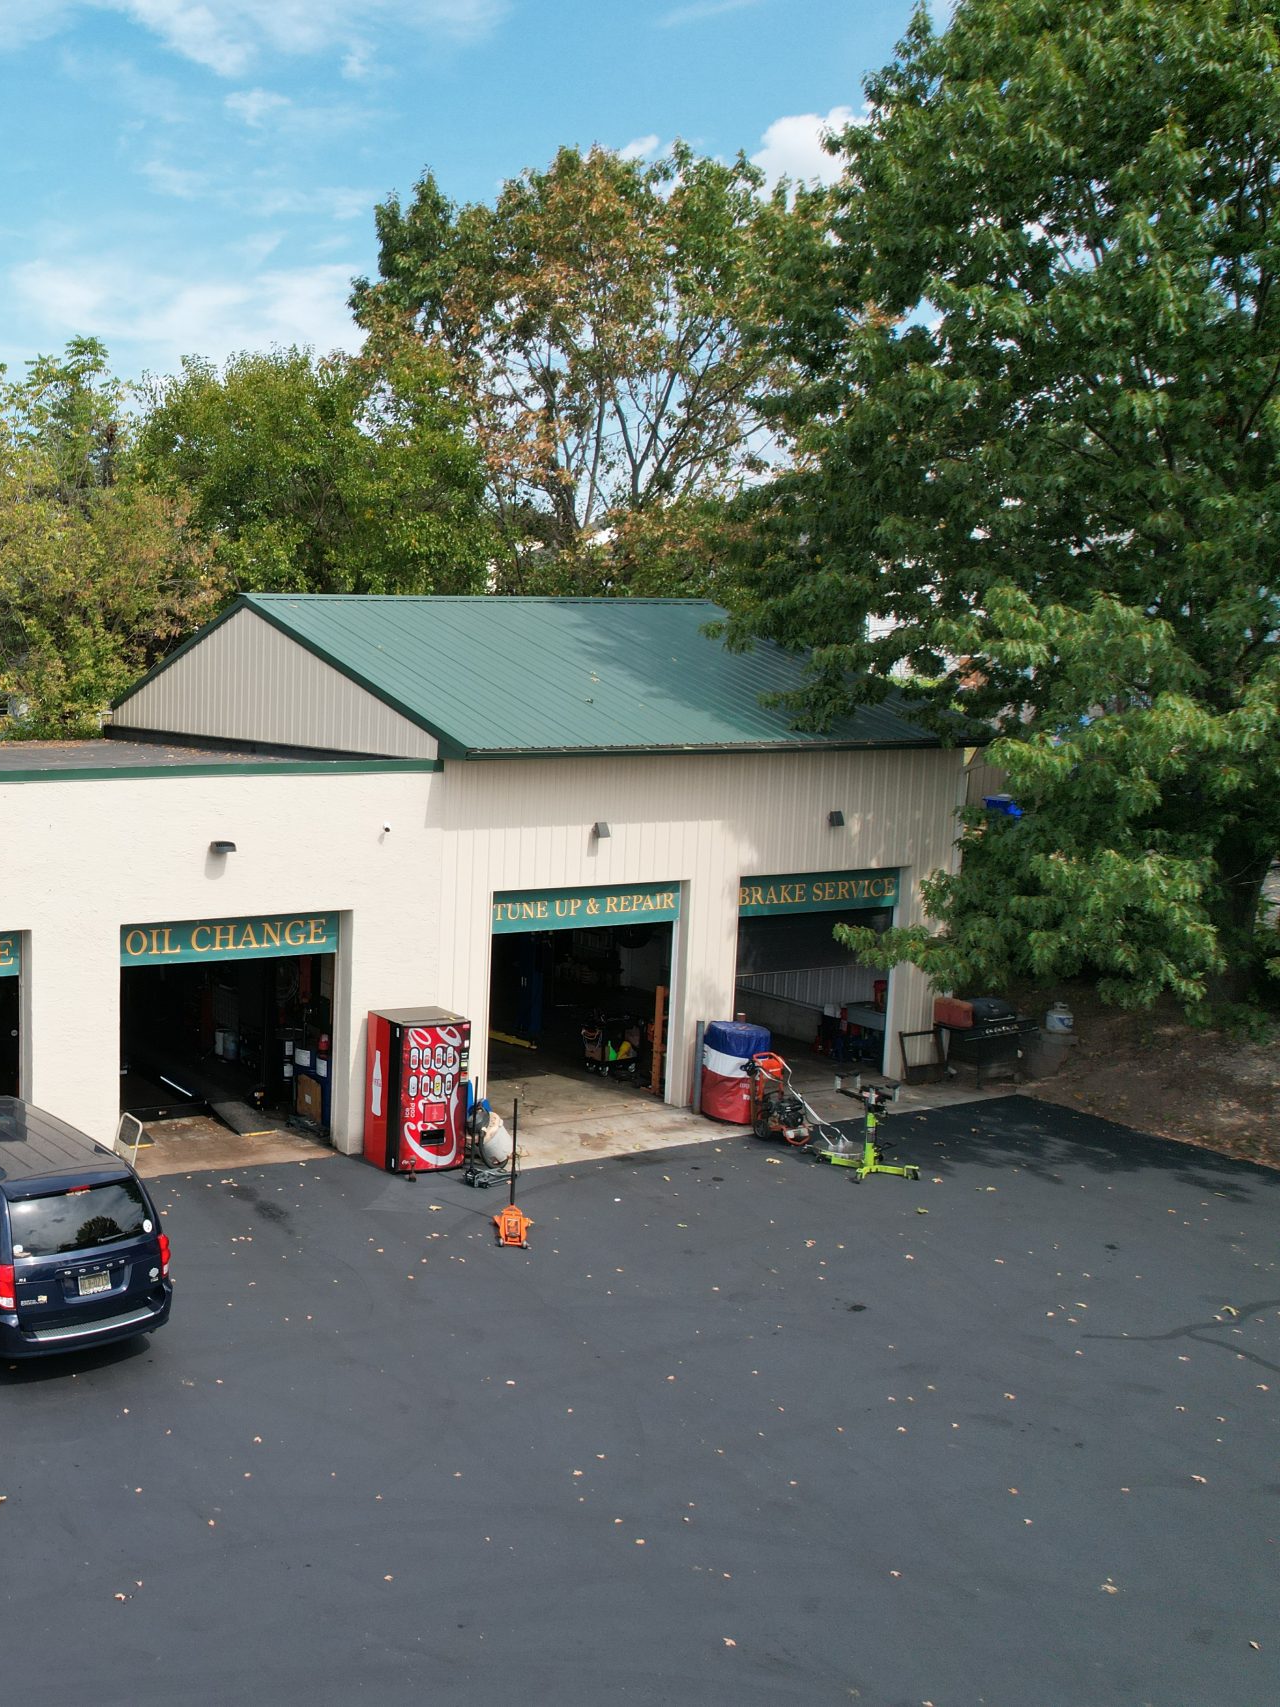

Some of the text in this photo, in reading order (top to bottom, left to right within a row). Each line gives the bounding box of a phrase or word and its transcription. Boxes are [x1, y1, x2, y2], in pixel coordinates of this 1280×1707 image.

[493, 892, 675, 921] TUNE UP & REPAIR
[738, 878, 896, 906] BRAKE SERVICE
[125, 919, 327, 956] OIL CHANGE
